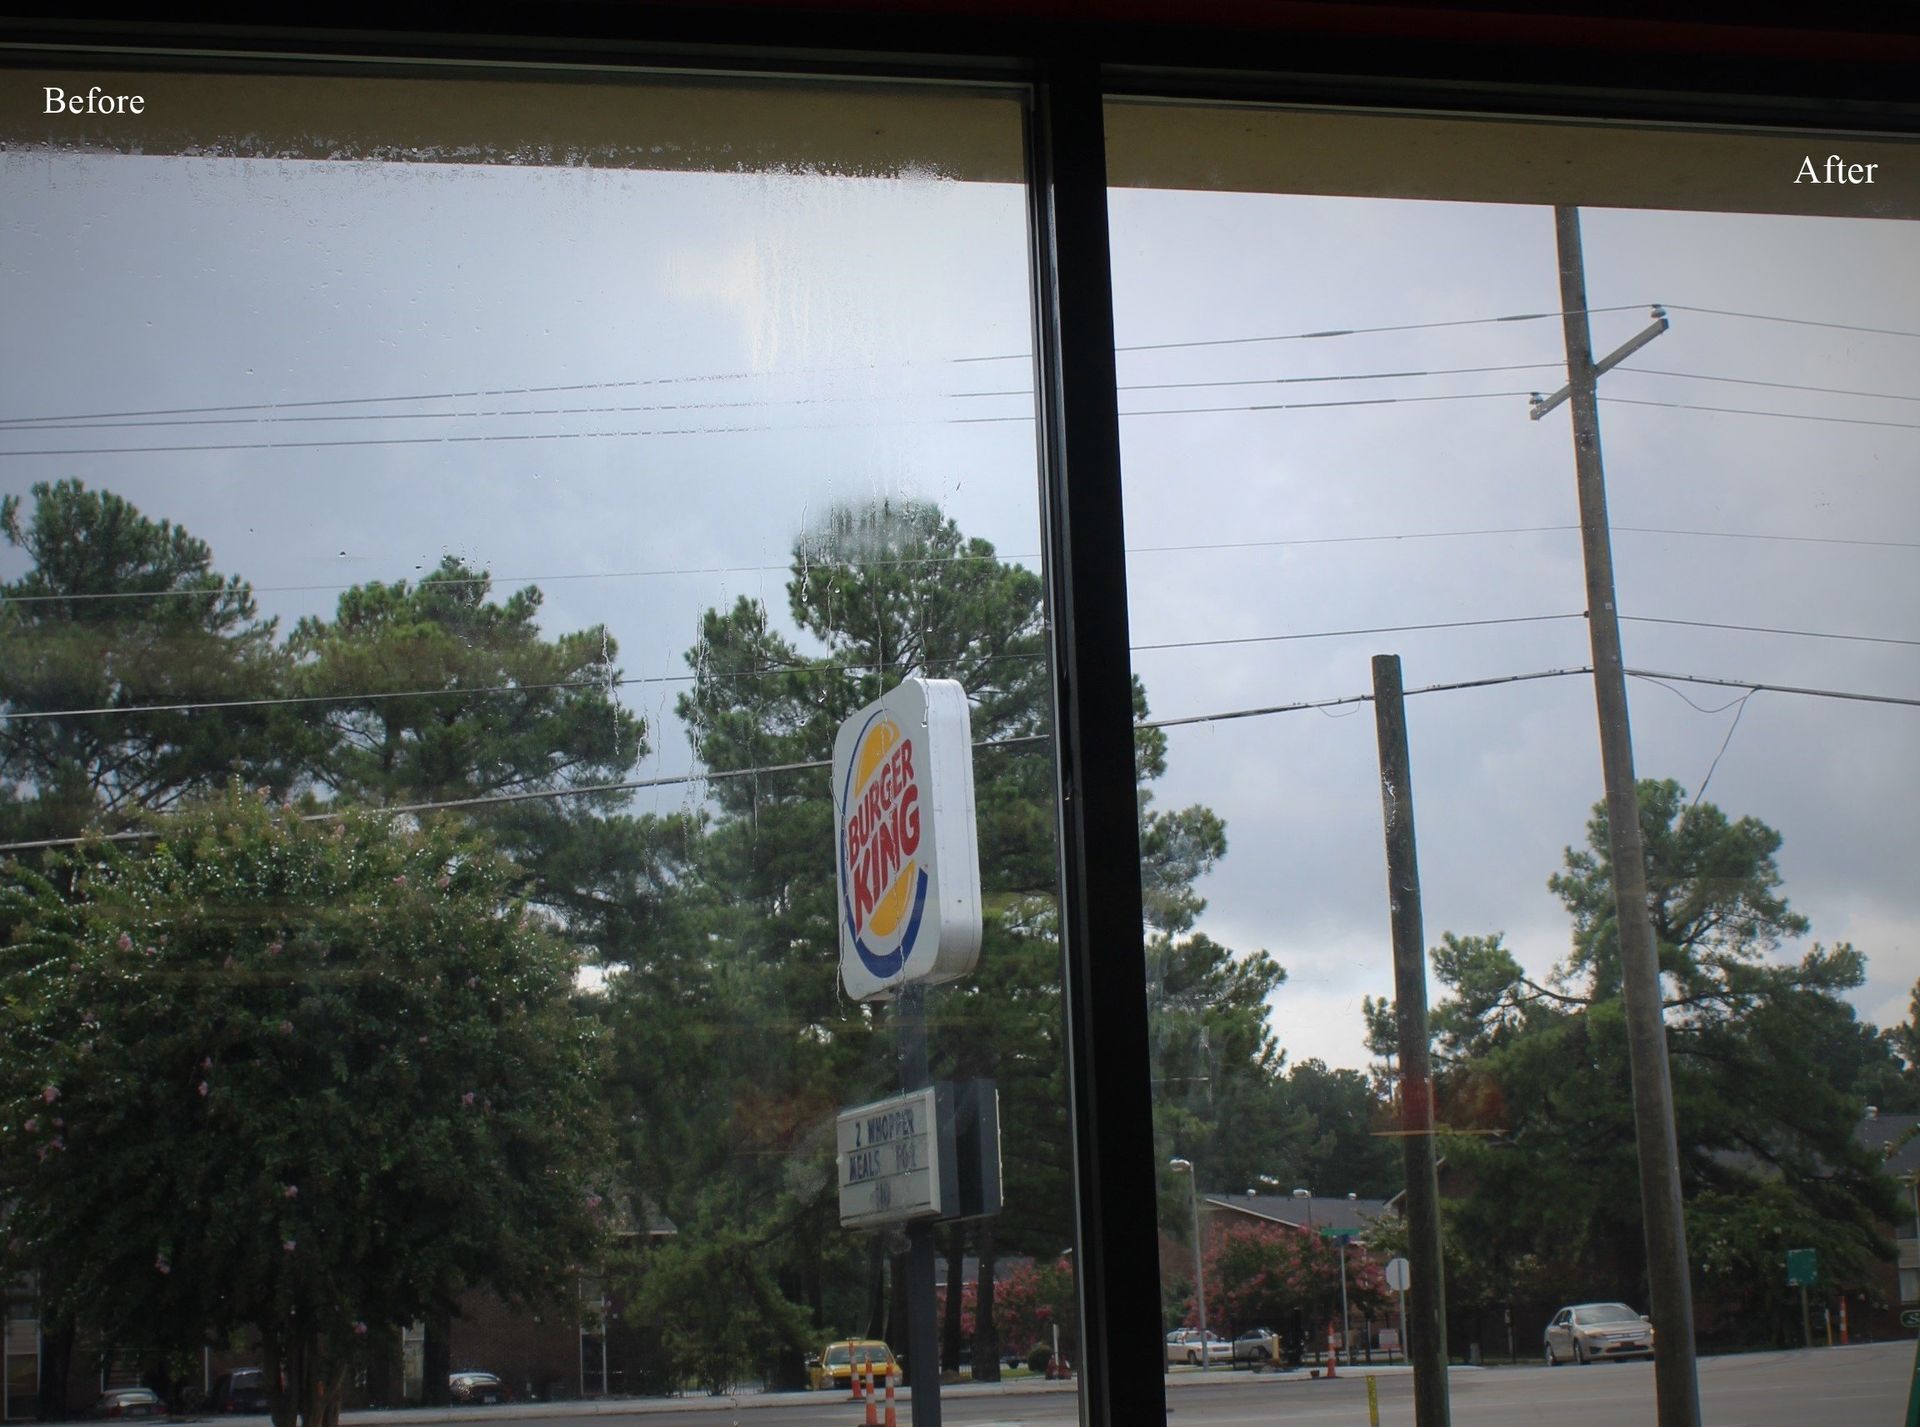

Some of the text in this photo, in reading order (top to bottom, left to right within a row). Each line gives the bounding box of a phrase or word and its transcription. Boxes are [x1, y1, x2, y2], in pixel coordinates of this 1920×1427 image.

[848, 738, 914, 871] BURGER
[853, 783, 921, 937] KING
[849, 1149, 881, 1181] MEALS
[855, 1109, 914, 1147] 2 WHOPPER
